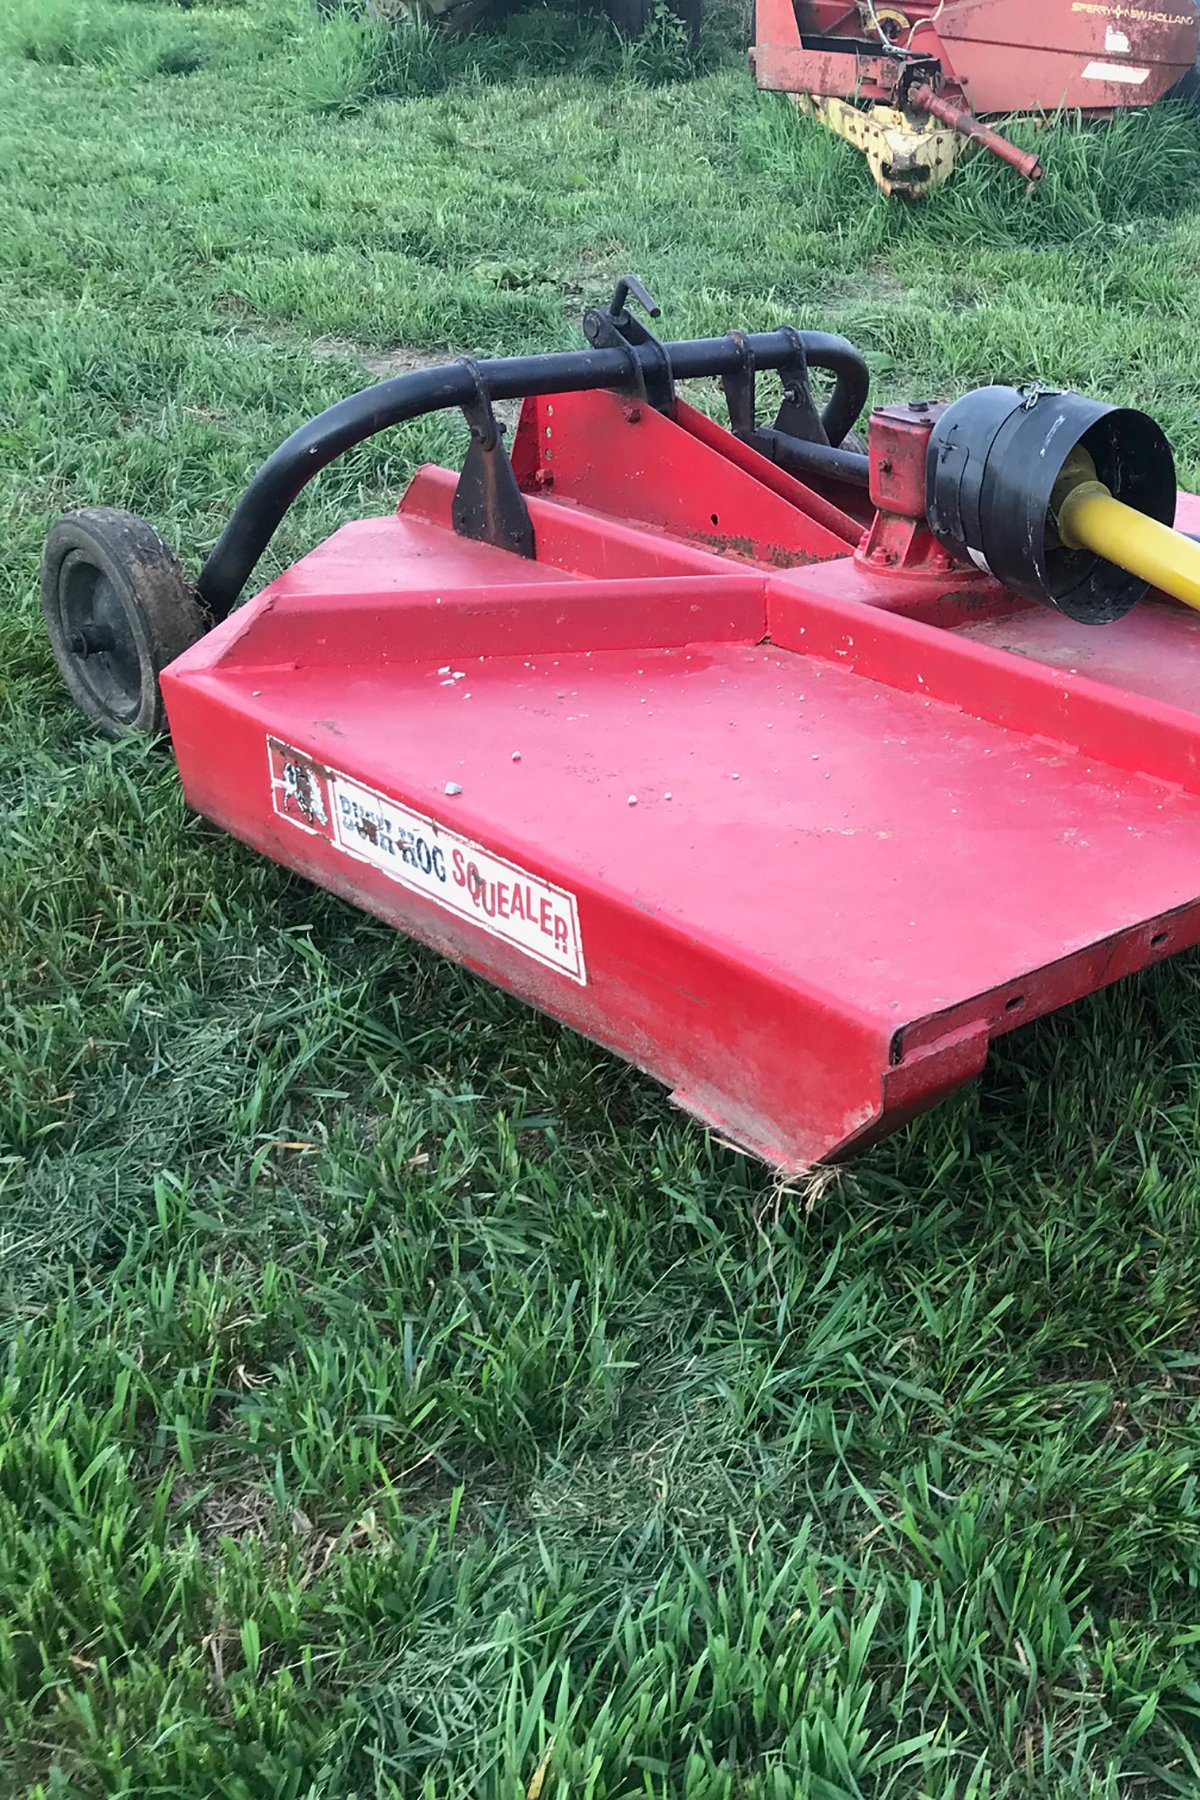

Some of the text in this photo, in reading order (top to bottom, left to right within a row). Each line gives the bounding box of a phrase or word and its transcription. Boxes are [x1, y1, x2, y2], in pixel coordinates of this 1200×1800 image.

[1071, 2, 1194, 25] SPERRY NEW HOLLAND
[452, 848, 568, 954] SQUEALER
